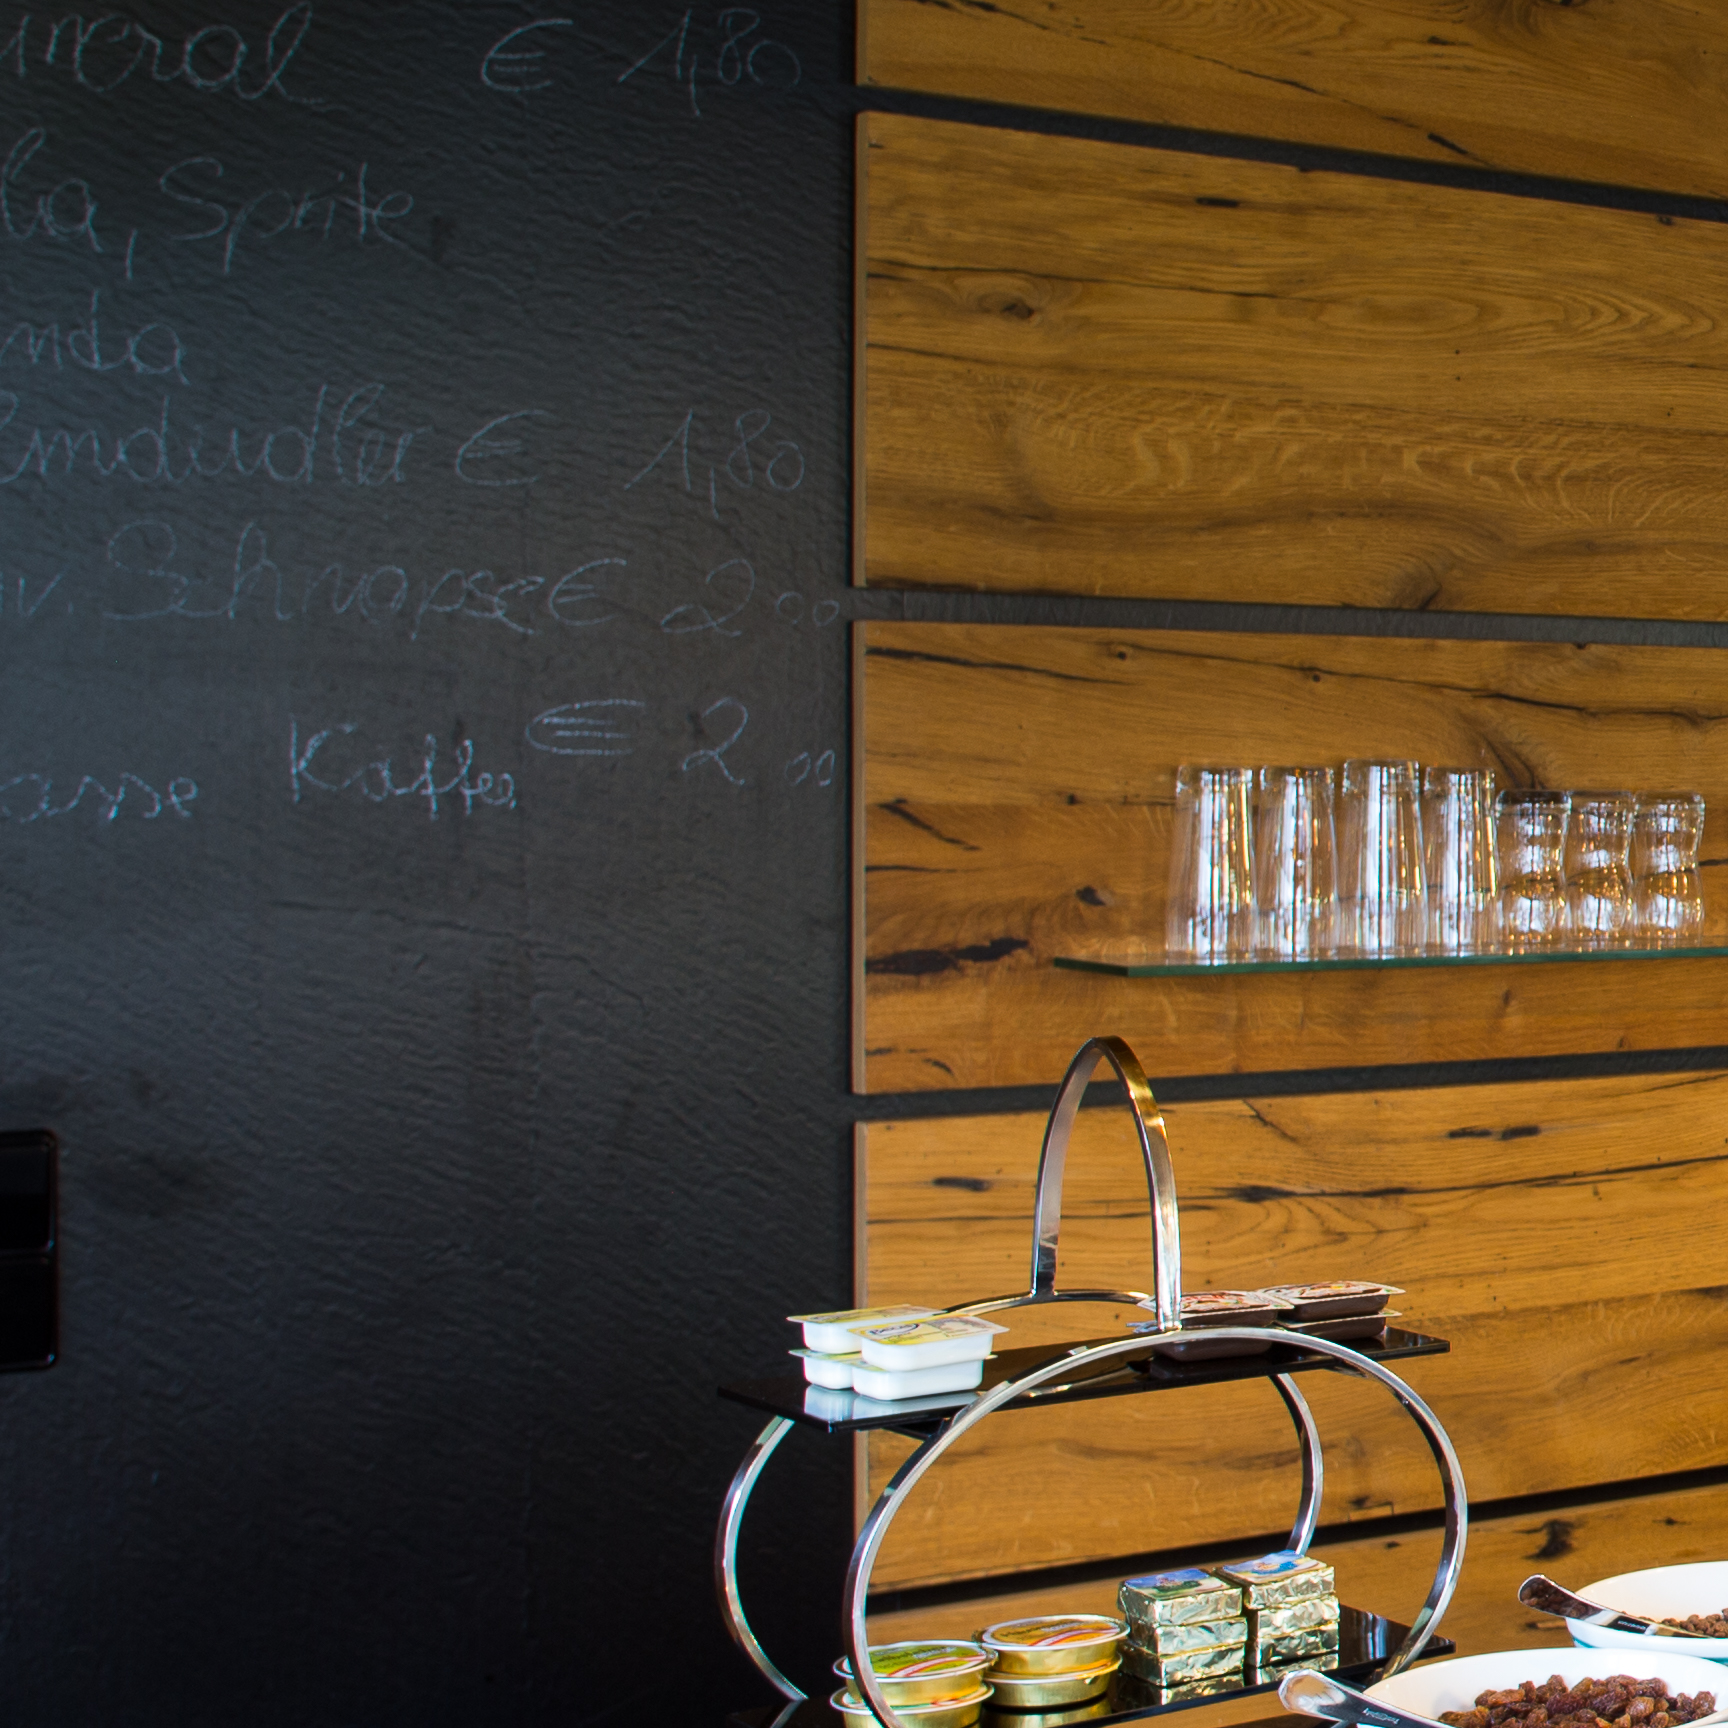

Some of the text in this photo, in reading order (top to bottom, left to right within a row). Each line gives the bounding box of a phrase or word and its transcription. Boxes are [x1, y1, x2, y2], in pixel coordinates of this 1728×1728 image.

[158, 157, 416, 274] Sprite
[454, 408, 556, 487] €
[623, 406, 805, 520] 1,80
[547, 558, 629, 627] €
[0, 770, 199, 823] asse
[525, 697, 647, 758] €
